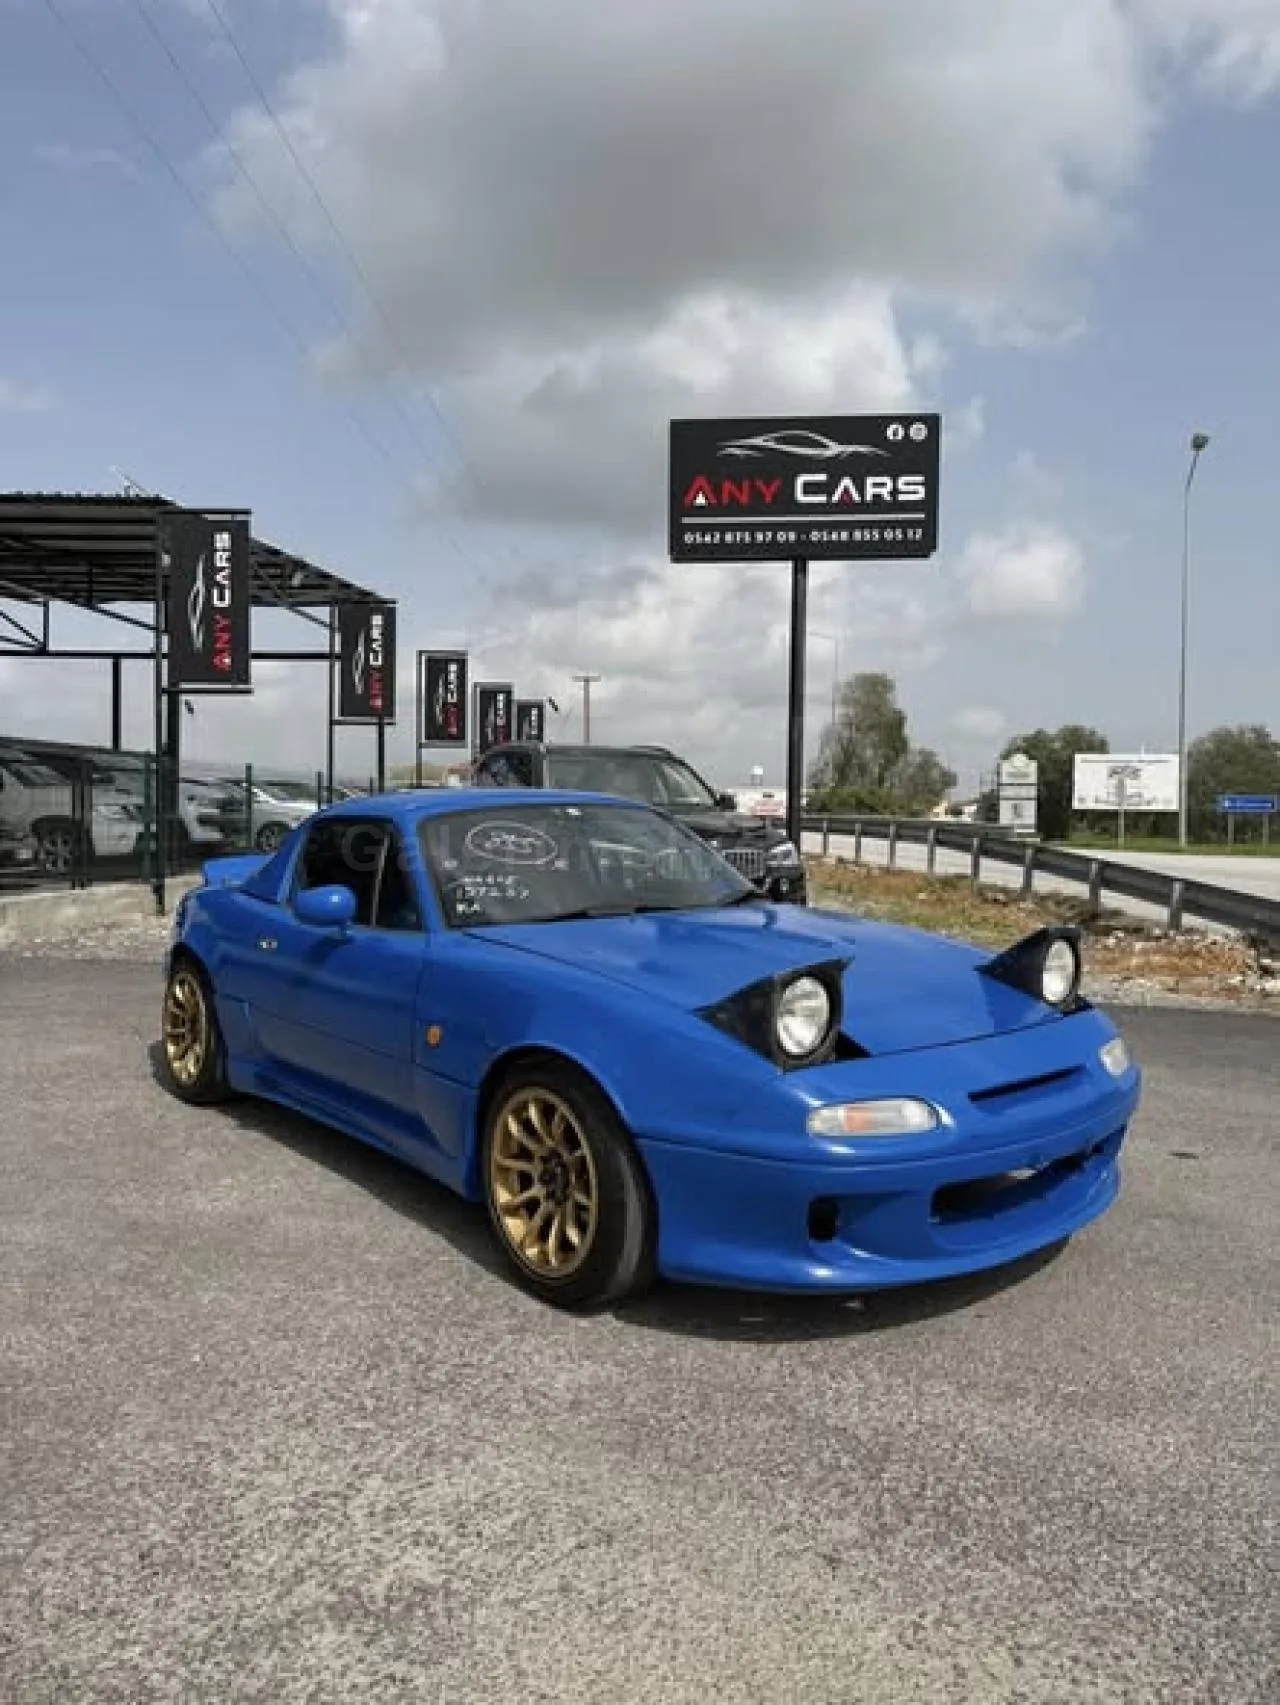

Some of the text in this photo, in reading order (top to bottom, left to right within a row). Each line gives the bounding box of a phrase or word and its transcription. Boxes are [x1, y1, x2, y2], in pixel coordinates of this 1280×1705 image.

[683, 473, 926, 507] ANY CARS
[211, 531, 232, 672] ANY CARS
